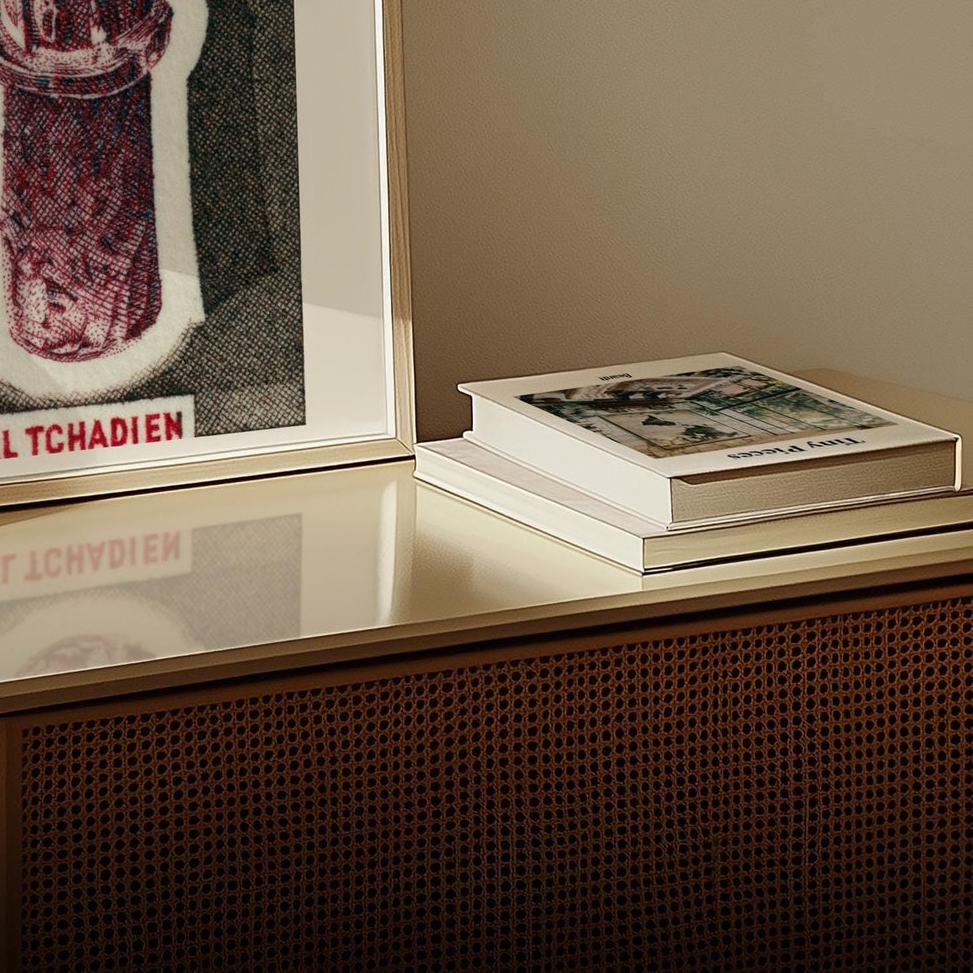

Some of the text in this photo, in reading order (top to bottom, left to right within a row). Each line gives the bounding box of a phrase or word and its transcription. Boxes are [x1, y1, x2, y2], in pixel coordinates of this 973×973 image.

[25, 411, 183, 456] TCHADIEN
[727, 437, 865, 459] Tiny Pieces
